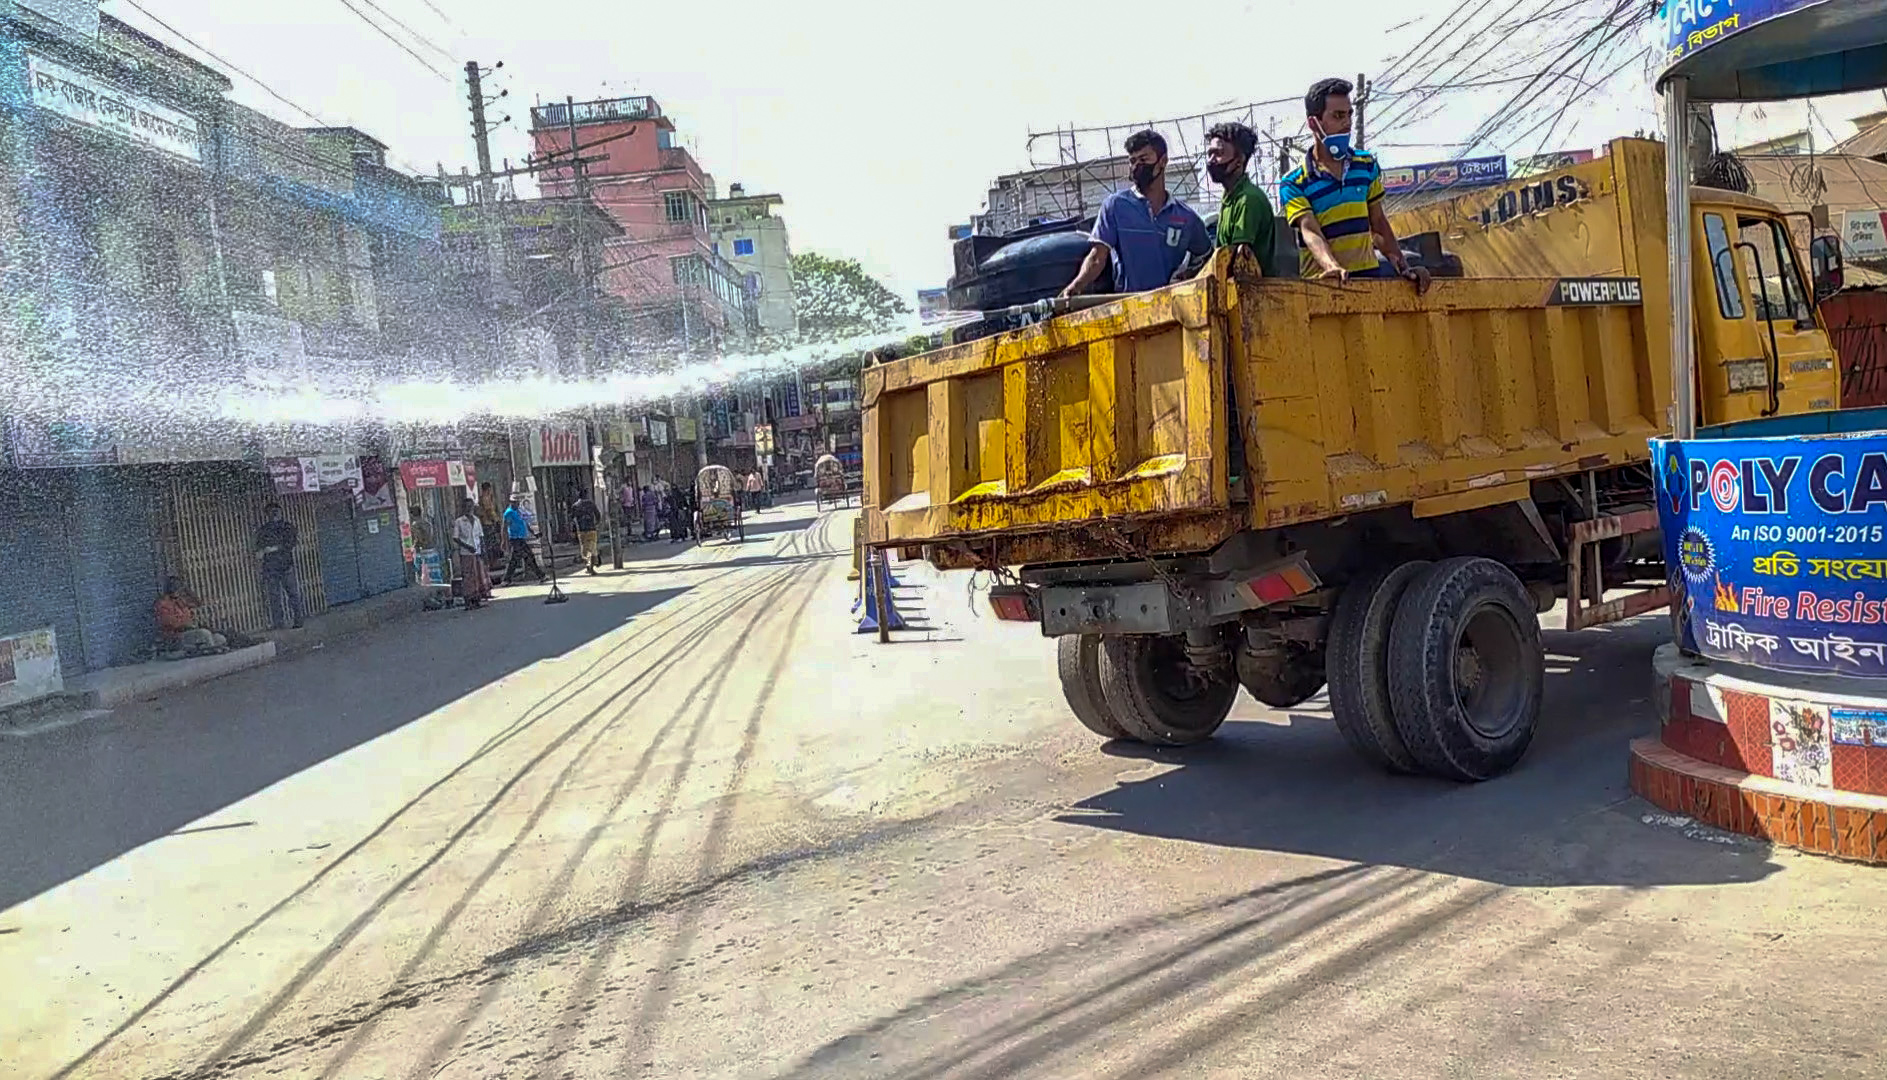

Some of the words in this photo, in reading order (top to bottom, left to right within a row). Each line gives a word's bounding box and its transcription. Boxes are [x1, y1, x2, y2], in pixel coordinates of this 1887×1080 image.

[1687, 13, 1740, 50] বিভাগ
[1560, 281, 1641, 302] POWERPLUS
[1688, 456, 1802, 513] POLY
[1731, 525, 1750, 541] An
[1753, 525, 1782, 542] ISO
[1786, 525, 1883, 543] 9001-2015
[1752, 550, 1801, 576] প্রতি
[1741, 586, 1790, 619] Fire
[1706, 618, 1779, 656] ট্রাফিক
[1788, 633, 1887, 667] আইন
